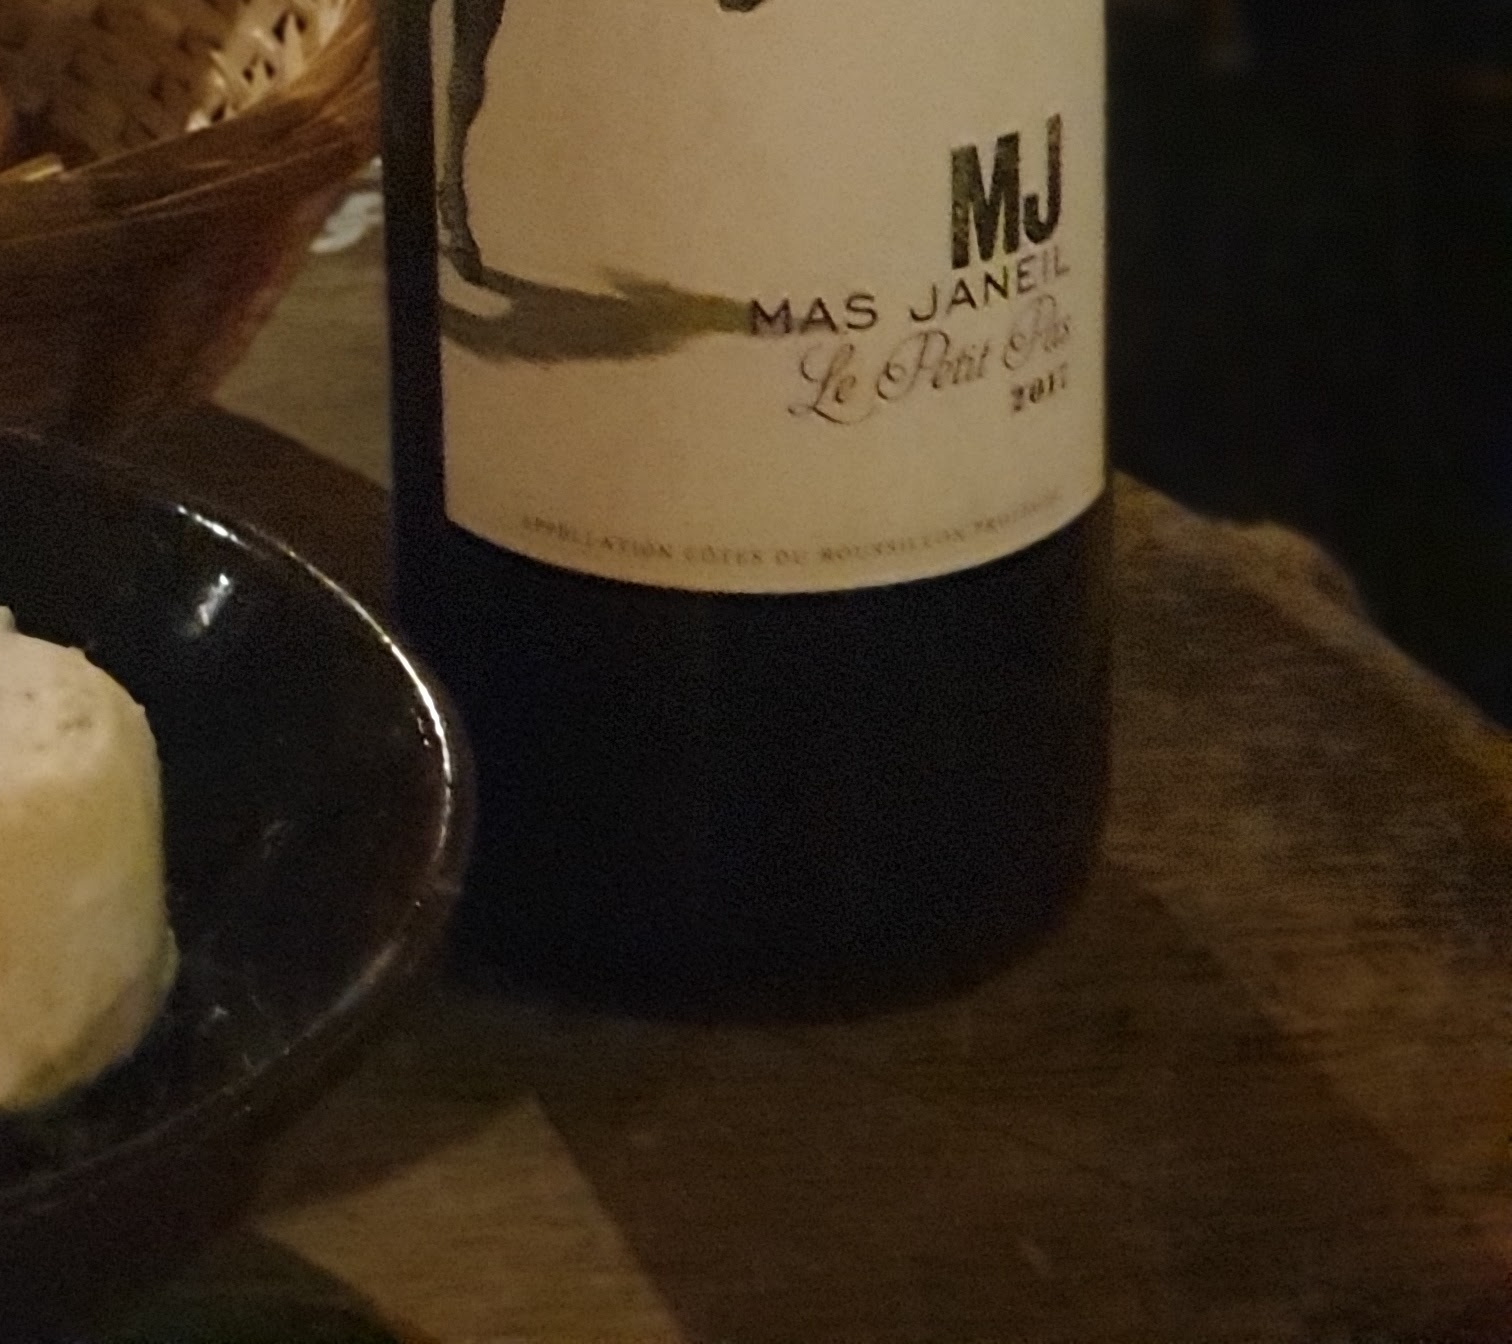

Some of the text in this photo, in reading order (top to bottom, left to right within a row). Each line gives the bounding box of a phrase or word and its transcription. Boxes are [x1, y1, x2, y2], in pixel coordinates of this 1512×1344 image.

[951, 113, 1062, 269] MJ
[750, 246, 1070, 336] MAS JANEIL
[788, 342, 868, 424] Le
[876, 330, 991, 402] Petit
